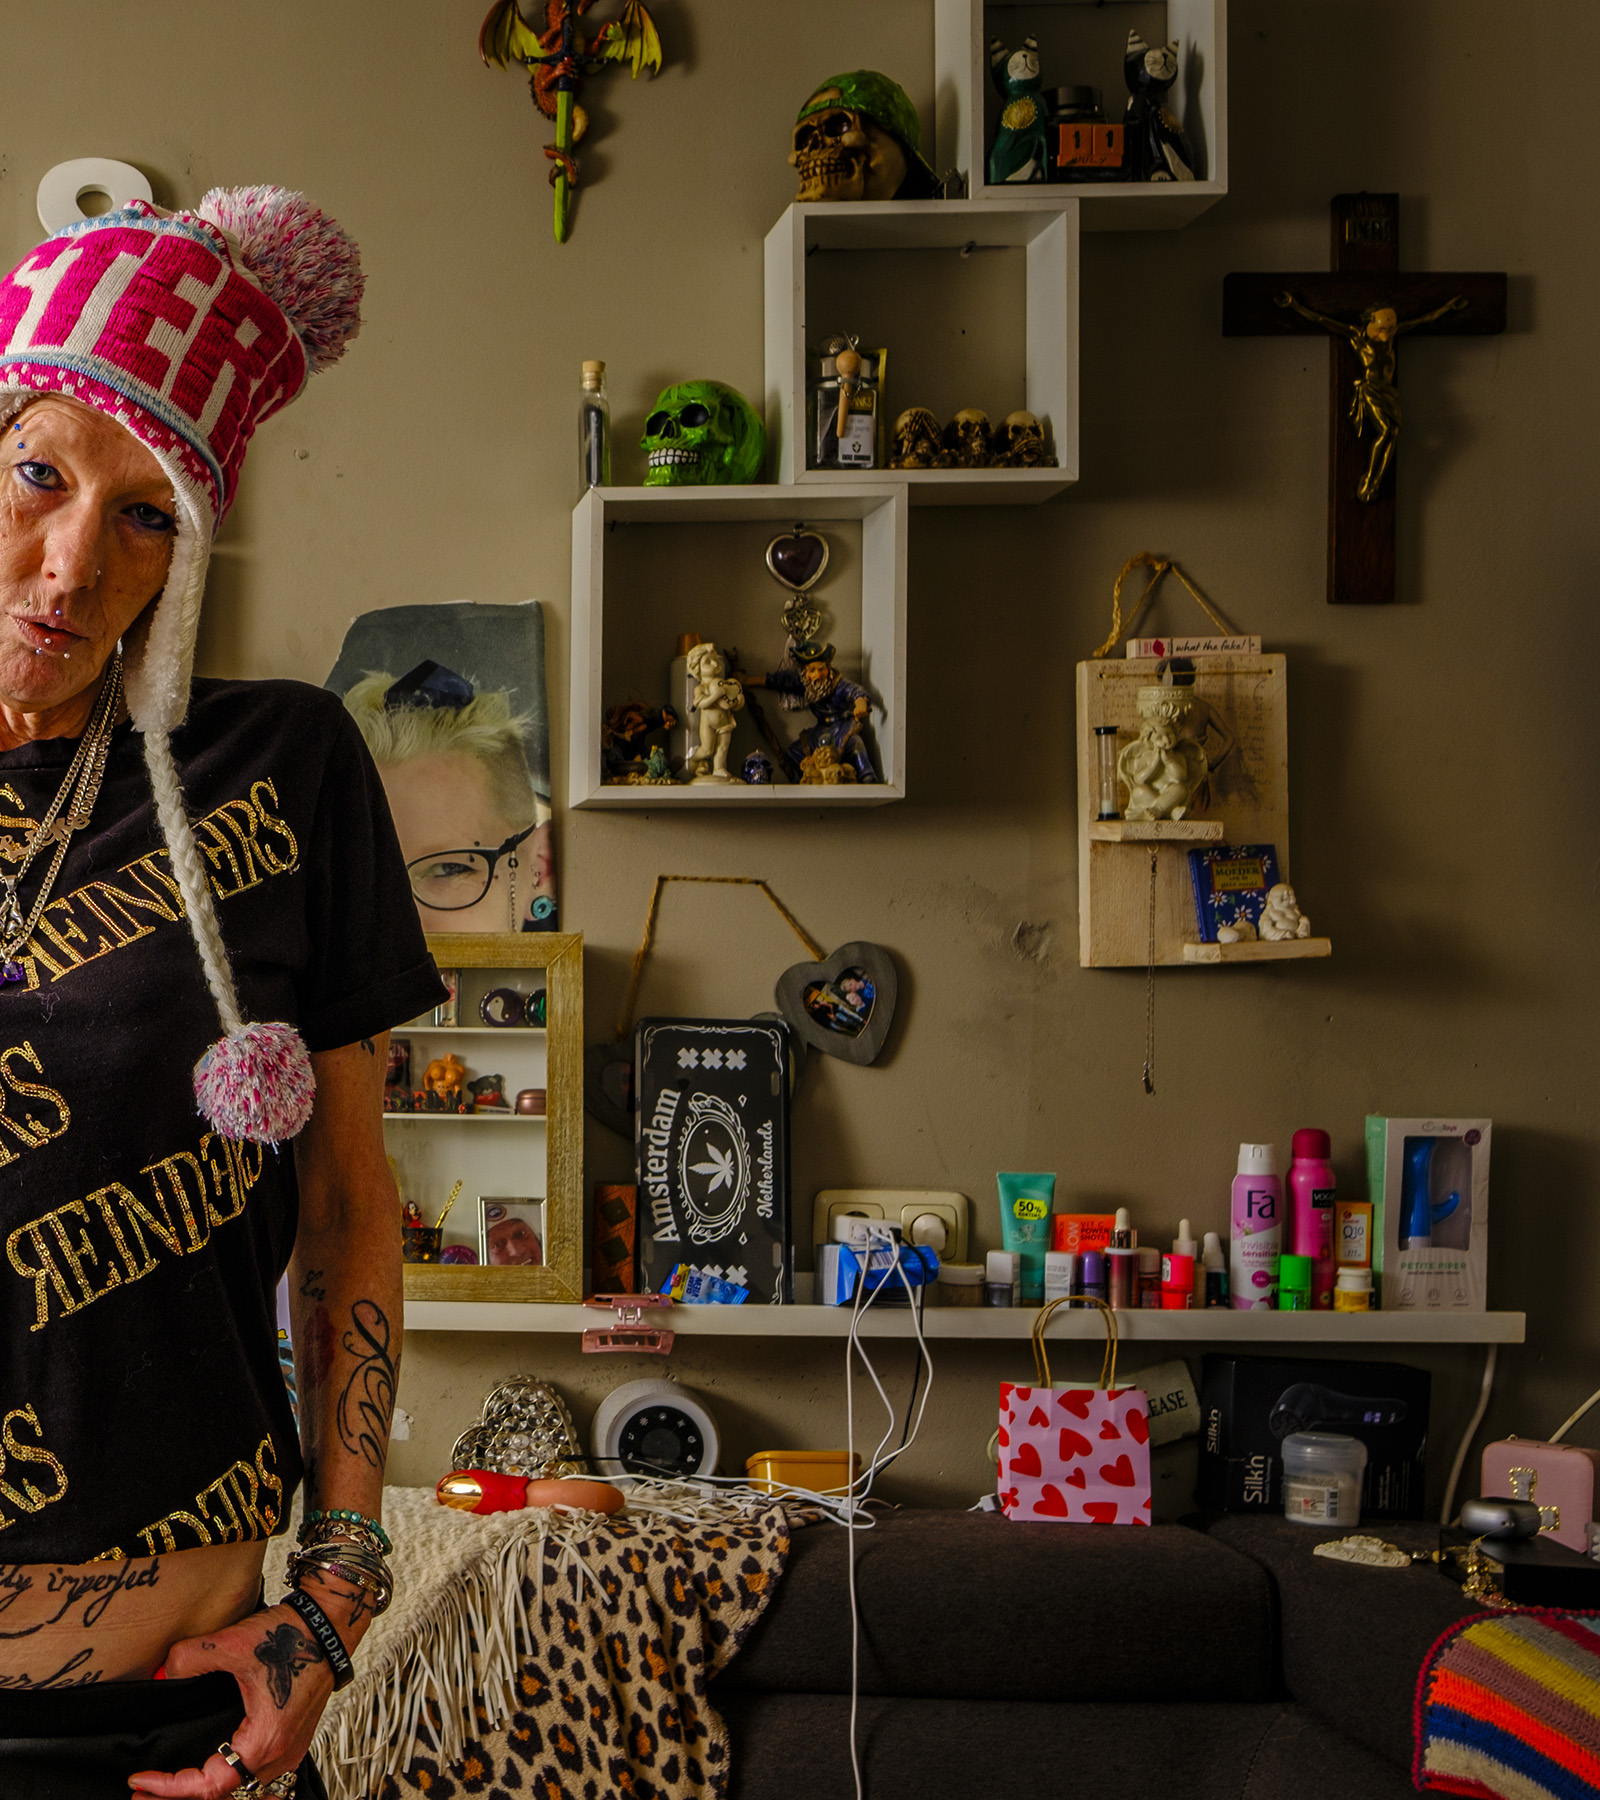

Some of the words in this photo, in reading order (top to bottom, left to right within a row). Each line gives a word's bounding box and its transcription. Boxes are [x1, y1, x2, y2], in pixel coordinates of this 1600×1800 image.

[1175, 640, 1201, 651] what
[1203, 640, 1218, 651] the
[1215, 866, 1261, 877] MOEDER
[642, 1088, 682, 1243] Amsterdam
[756, 1119, 774, 1219] Netherlands
[1018, 1201, 1042, 1213] 50%
[1246, 1189, 1276, 1219] Fa
[1067, 1221, 1080, 1254] LOW
[1401, 1262, 1434, 1270] PETITE
[1438, 1262, 1467, 1270] PIPER
[1149, 1390, 1188, 1418] EASE
[47, 1556, 160, 1628] imperfect
